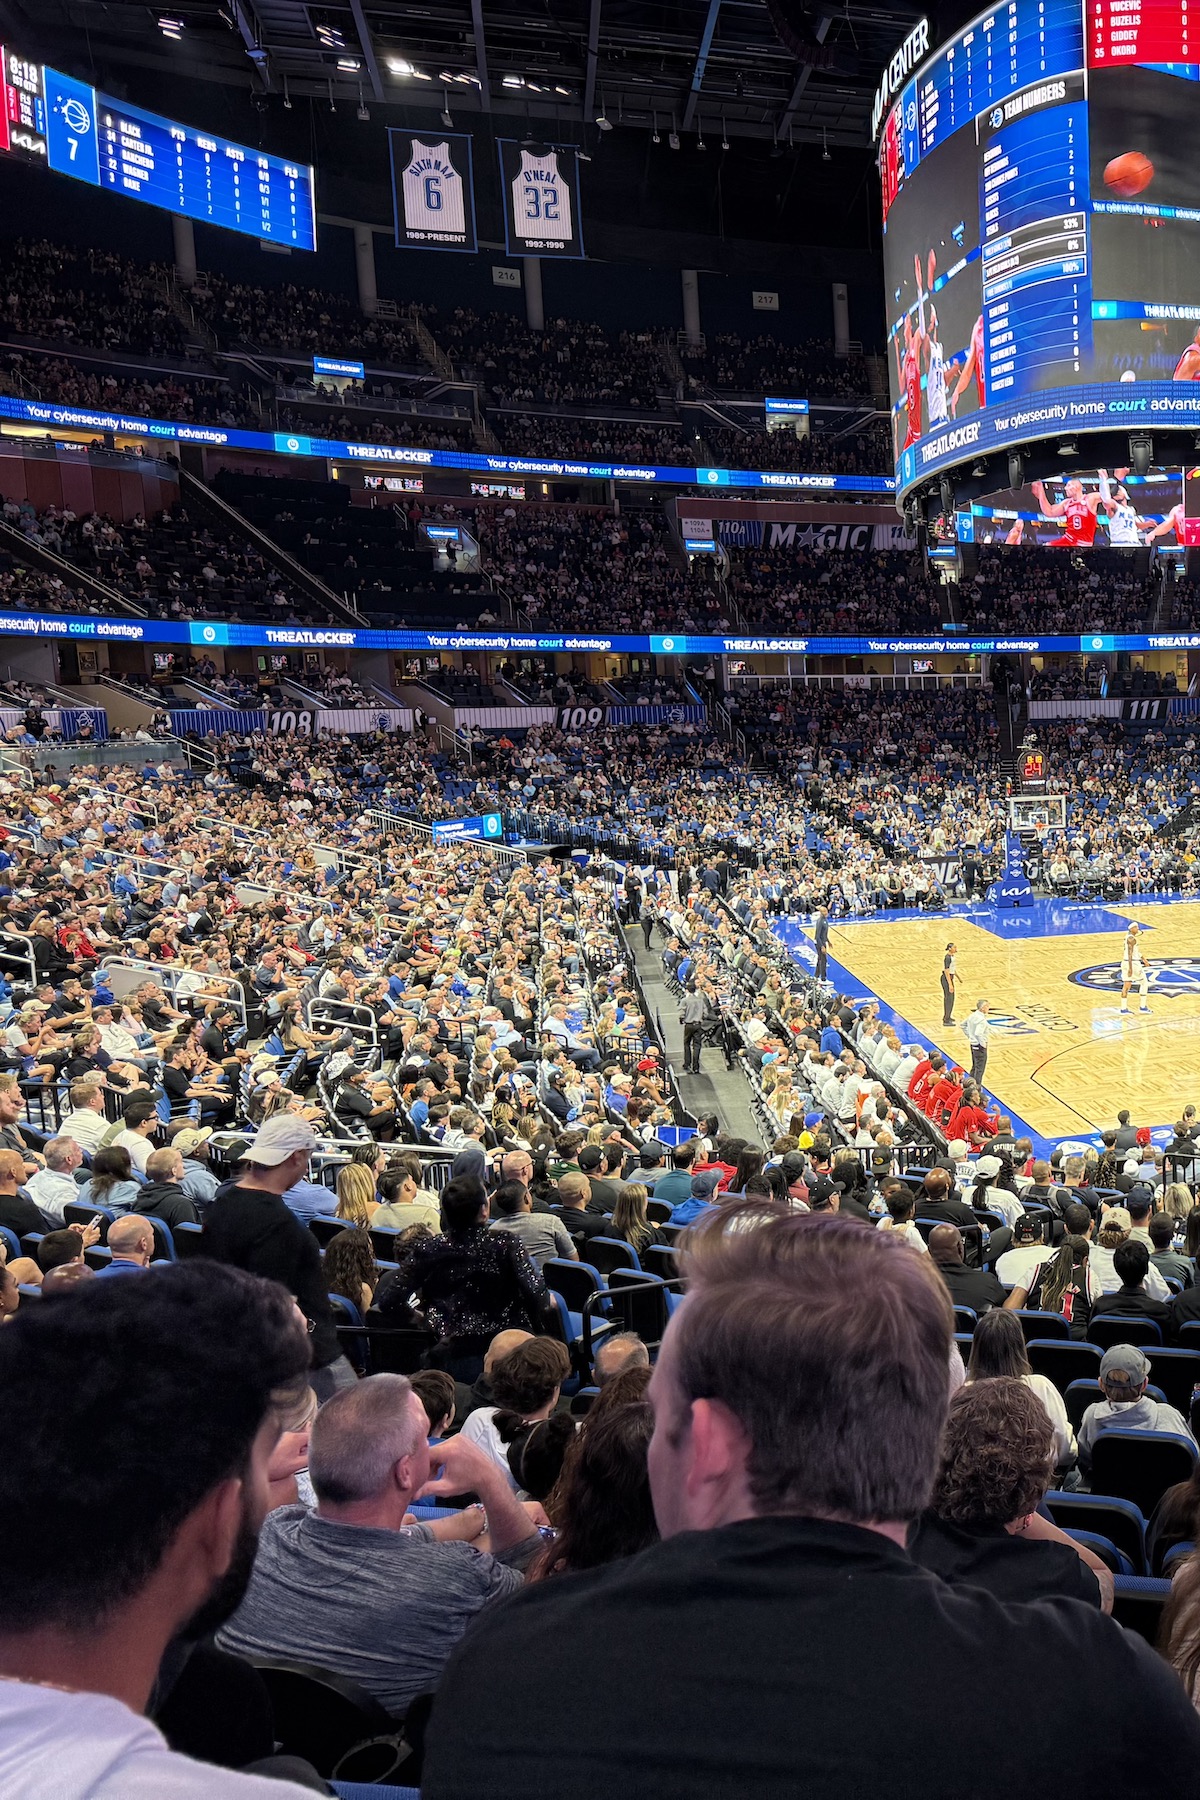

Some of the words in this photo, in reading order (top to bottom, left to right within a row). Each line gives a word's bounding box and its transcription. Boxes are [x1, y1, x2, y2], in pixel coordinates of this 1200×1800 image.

[1095, 18, 1103, 29] 14
[1110, 15, 1141, 27] BUZELIS
[1097, 33, 1102, 43] 3
[1111, 30, 1138, 42] GIDDEY
[889, 19, 929, 93] CENTER
[1095, 48, 1104, 58] 35
[1111, 44, 1137, 56] OKORO
[10, 56, 37, 84] 8:18
[20, 92, 31, 106] FLS
[1004, 96, 1022, 120] TEAM
[1023, 81, 1065, 108] NUMBERS
[67, 138, 78, 161] 7
[409, 159, 432, 177] SIXTH
[434, 159, 454, 180] MAN
[524, 170, 557, 185] O'NEAL
[424, 176, 443, 211] 6
[524, 186, 560, 220] 32
[406, 231, 466, 243] 1989-PRESENT
[525, 240, 564, 249] 1992-1996
[498, 272, 515, 281] 216
[758, 296, 774, 304] 217
[994, 419, 1009, 431] Your
[1010, 405, 1068, 428] cybersecurity
[1070, 402, 1105, 415] home
[1109, 398, 1146, 411] court
[27, 406, 51, 418] Your
[54, 408, 118, 430] cybersecurity
[121, 419, 148, 432] home
[150, 426, 175, 435] court
[178, 428, 227, 443] advantage
[922, 421, 980, 463] THREATLOCKER
[347, 446, 433, 462] THREATLOCKER
[487, 459, 507, 468] Your
[509, 461, 563, 474] cybersecurity
[565, 464, 588, 473] home
[613, 468, 655, 479] advantage
[761, 475, 836, 486] THREATLOCKER
[719, 522, 745, 534] 110A
[771, 524, 868, 550] MAGIC
[0, 618, 39, 633] ersecurity
[41, 619, 67, 632] home
[69, 623, 95, 633] court
[97, 623, 143, 638] advantage
[266, 631, 356, 644] THREATLOCKER
[428, 636, 448, 645] Your
[450, 637, 509, 648] cybersecurity
[511, 638, 537, 646] home
[538, 639, 563, 647] court
[565, 639, 611, 650] advantage
[723, 640, 808, 650] THREATLOCKER
[890, 641, 945, 651] cybersecurity
[946, 641, 970, 649] home
[996, 641, 1039, 650] advantage
[850, 677, 866, 685] 110
[1129, 700, 1159, 718] 111
[268, 710, 312, 736] 108
[560, 708, 602, 730] 109
[1025, 763, 1041, 776] 24
[1016, 1004, 1079, 1031] CENTER
[993, 1144, 1016, 1152] SECURIT
